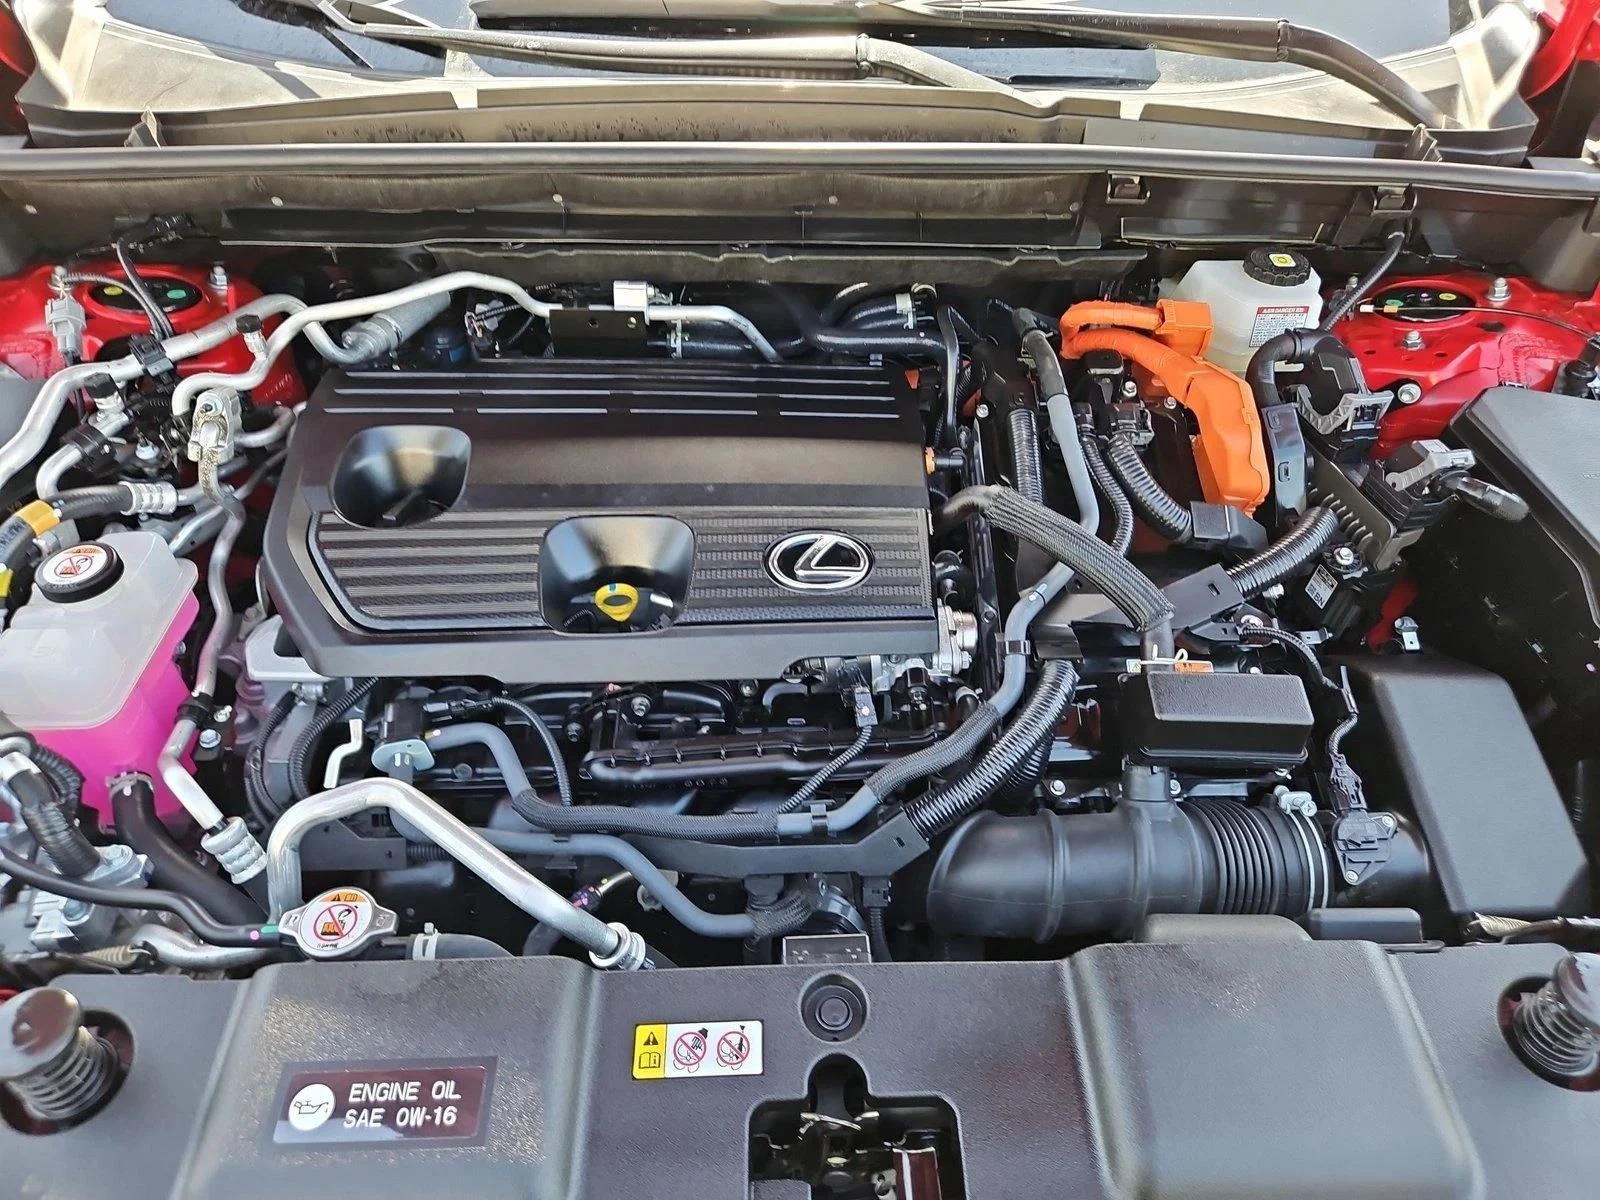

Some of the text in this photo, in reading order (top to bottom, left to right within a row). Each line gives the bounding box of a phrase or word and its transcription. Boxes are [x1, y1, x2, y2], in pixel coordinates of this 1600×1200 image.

[349, 1079, 462, 1102] ENGINE OIL
[344, 1106, 458, 1128] SAE 0W-16
